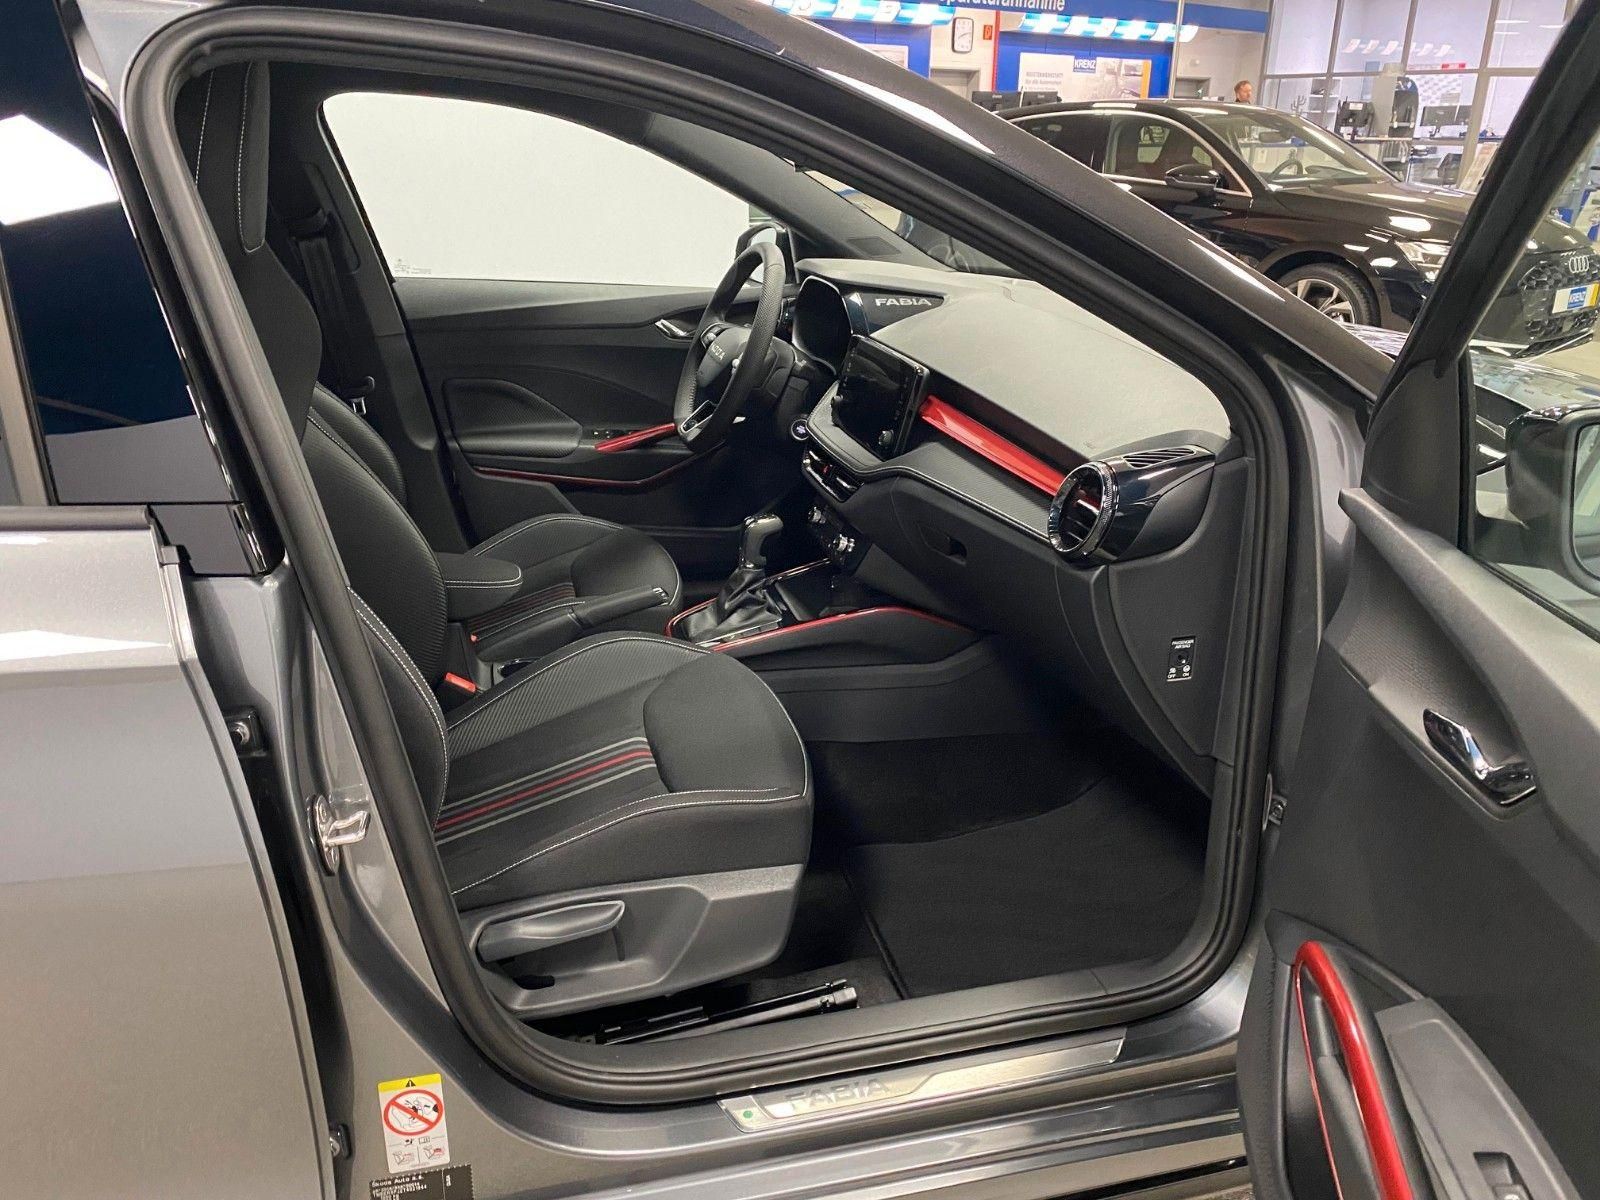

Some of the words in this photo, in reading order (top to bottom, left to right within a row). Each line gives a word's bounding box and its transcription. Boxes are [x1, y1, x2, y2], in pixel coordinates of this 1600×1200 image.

[1074, 59, 1096, 69] KRENZ
[875, 298, 932, 306] FABIA
[785, 1078, 890, 1111] FABIA
[394, 1176, 410, 1184] Auto
